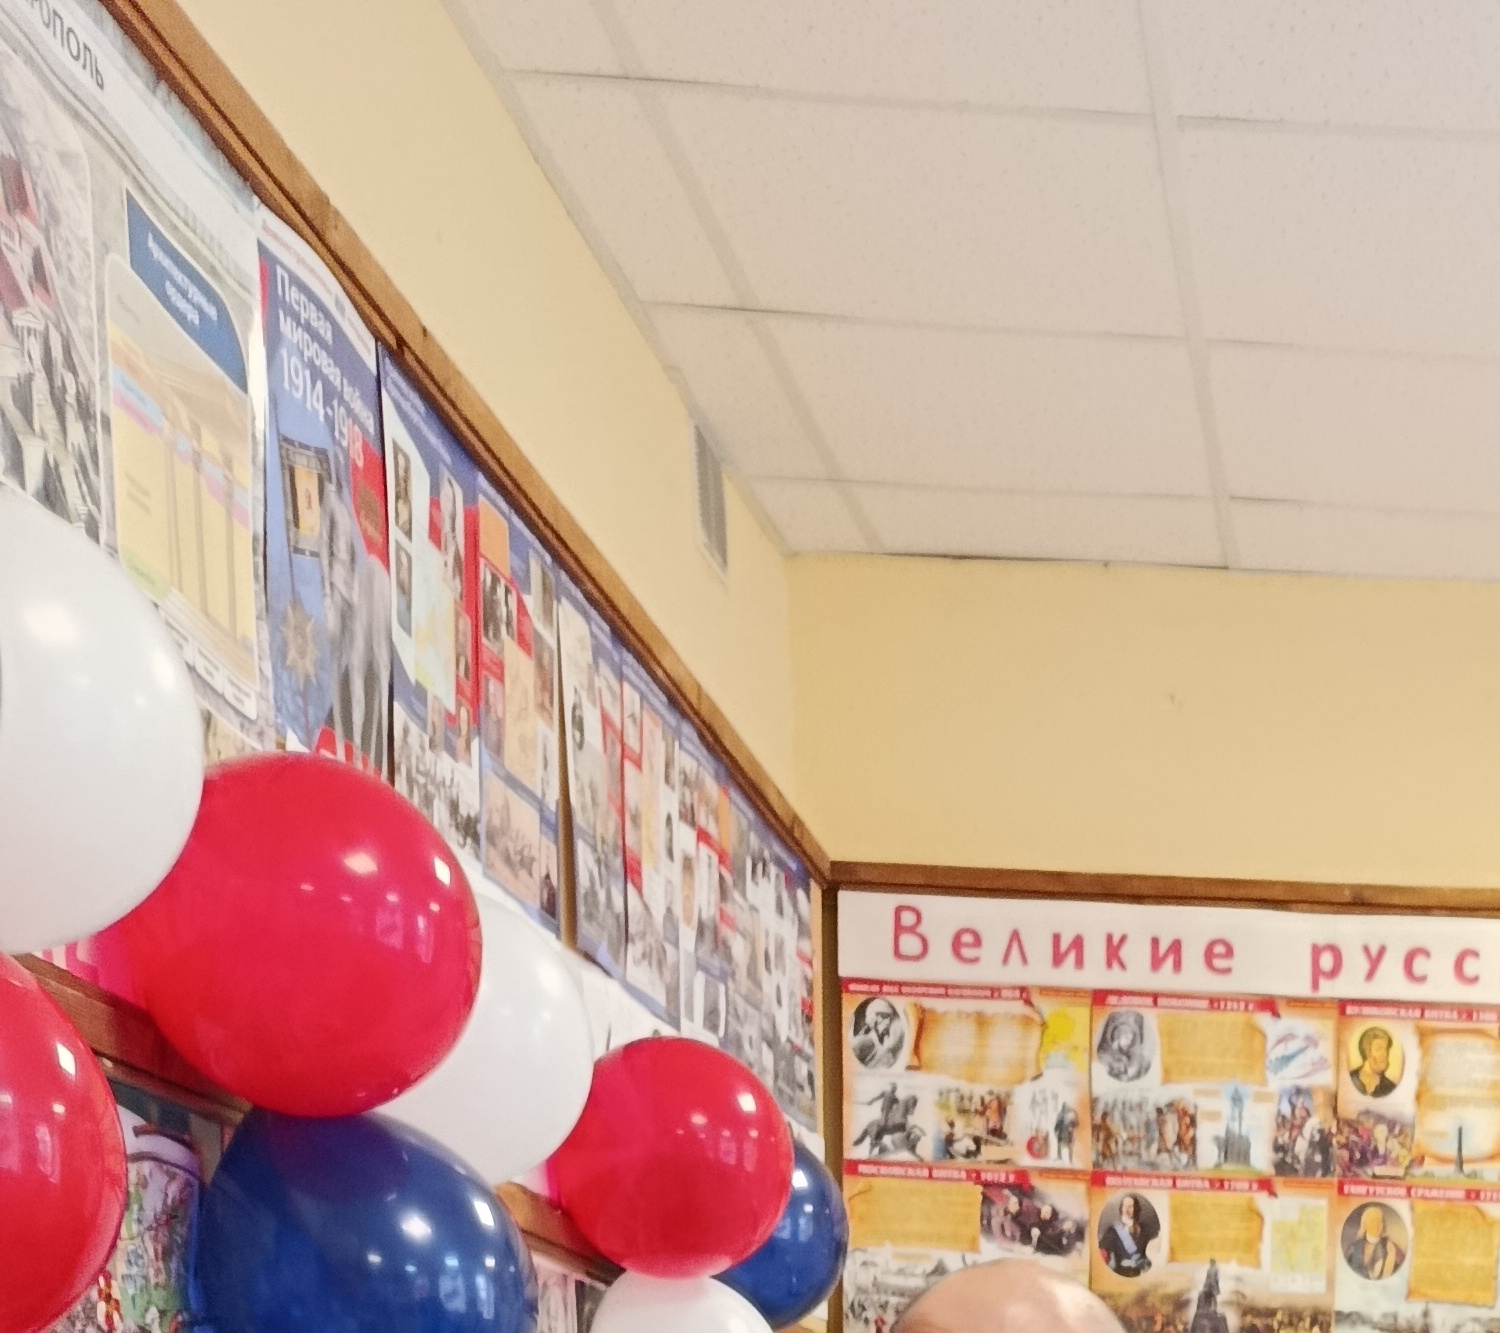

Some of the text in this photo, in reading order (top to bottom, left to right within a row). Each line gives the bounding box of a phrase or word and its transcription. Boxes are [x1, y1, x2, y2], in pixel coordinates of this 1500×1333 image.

[276, 263, 334, 346] Первая
[282, 346, 366, 469] 1914-1918
[891, 903, 1237, 977] Великие
